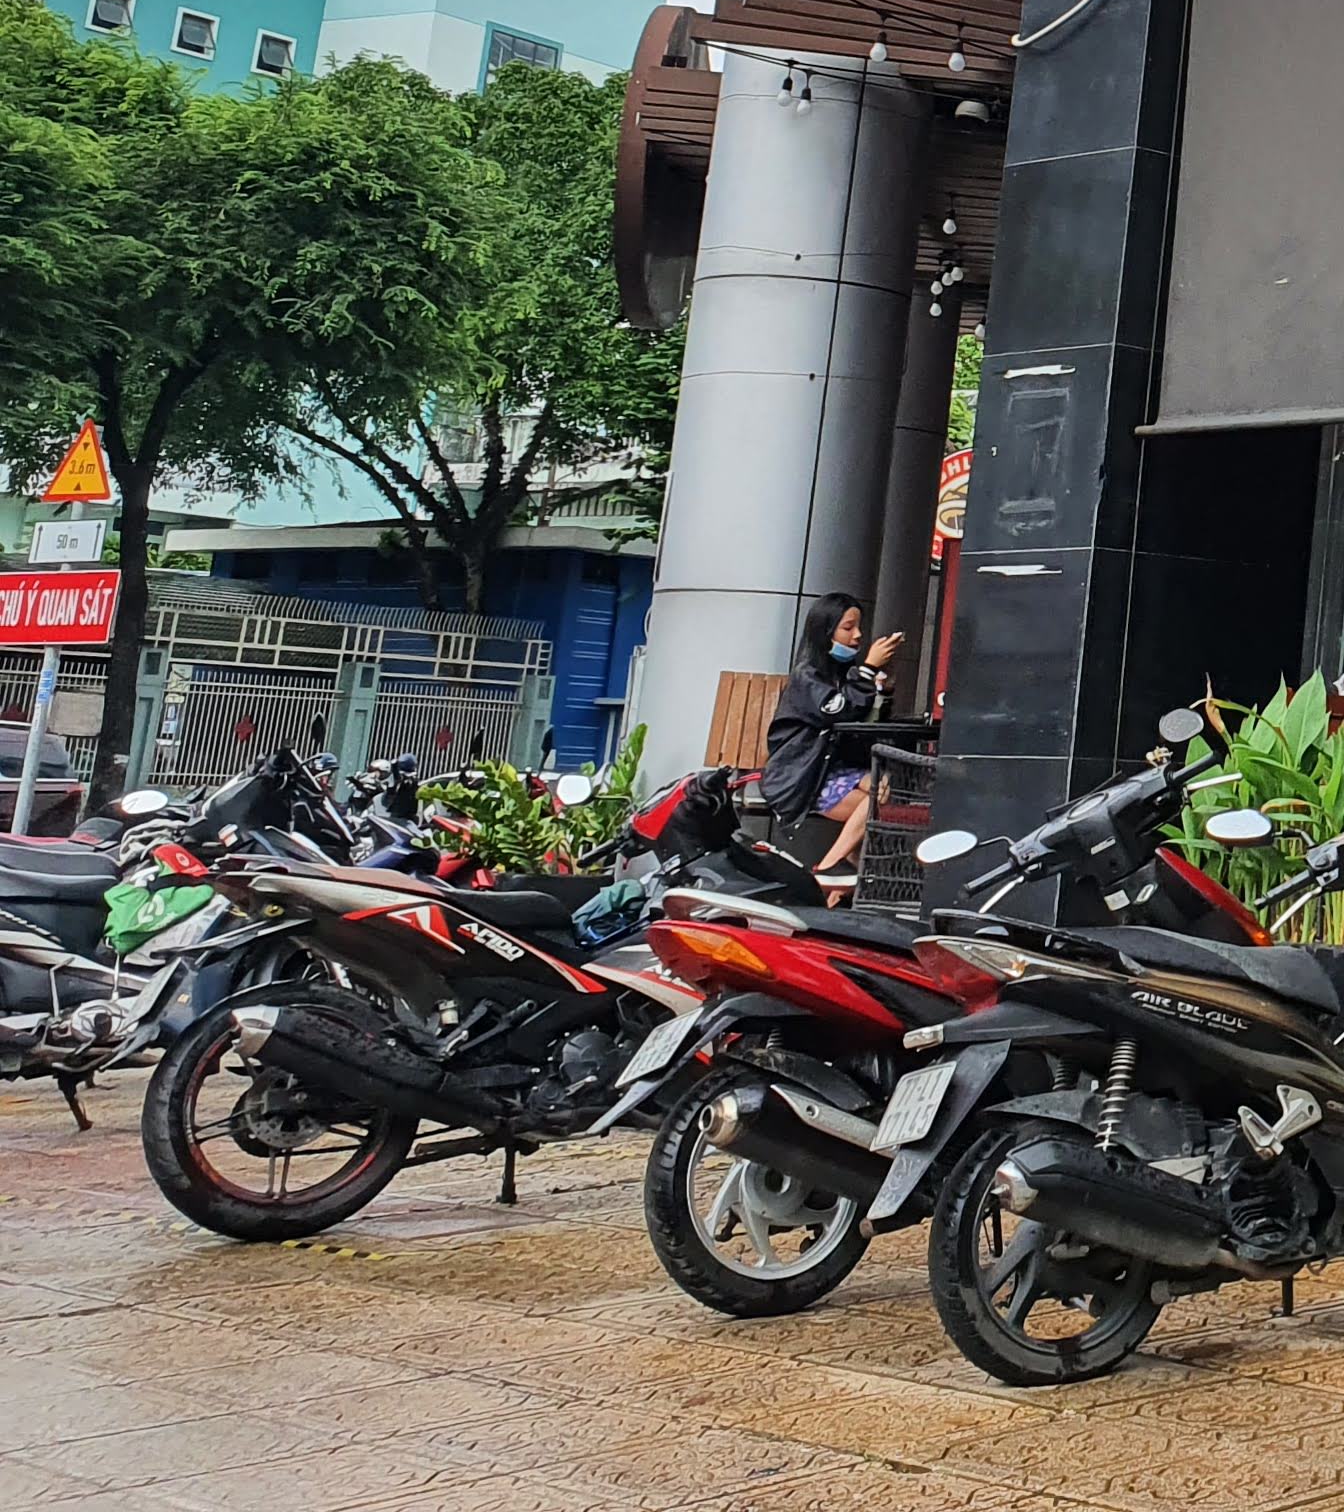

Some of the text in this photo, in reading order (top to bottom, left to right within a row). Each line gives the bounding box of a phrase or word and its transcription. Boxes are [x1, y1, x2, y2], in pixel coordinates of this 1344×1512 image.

[24, 580, 40, 627] Ý
[37, 588, 80, 626] QUAN
[79, 579, 113, 626] SÁT
[1130, 990, 1172, 1008] AIR
